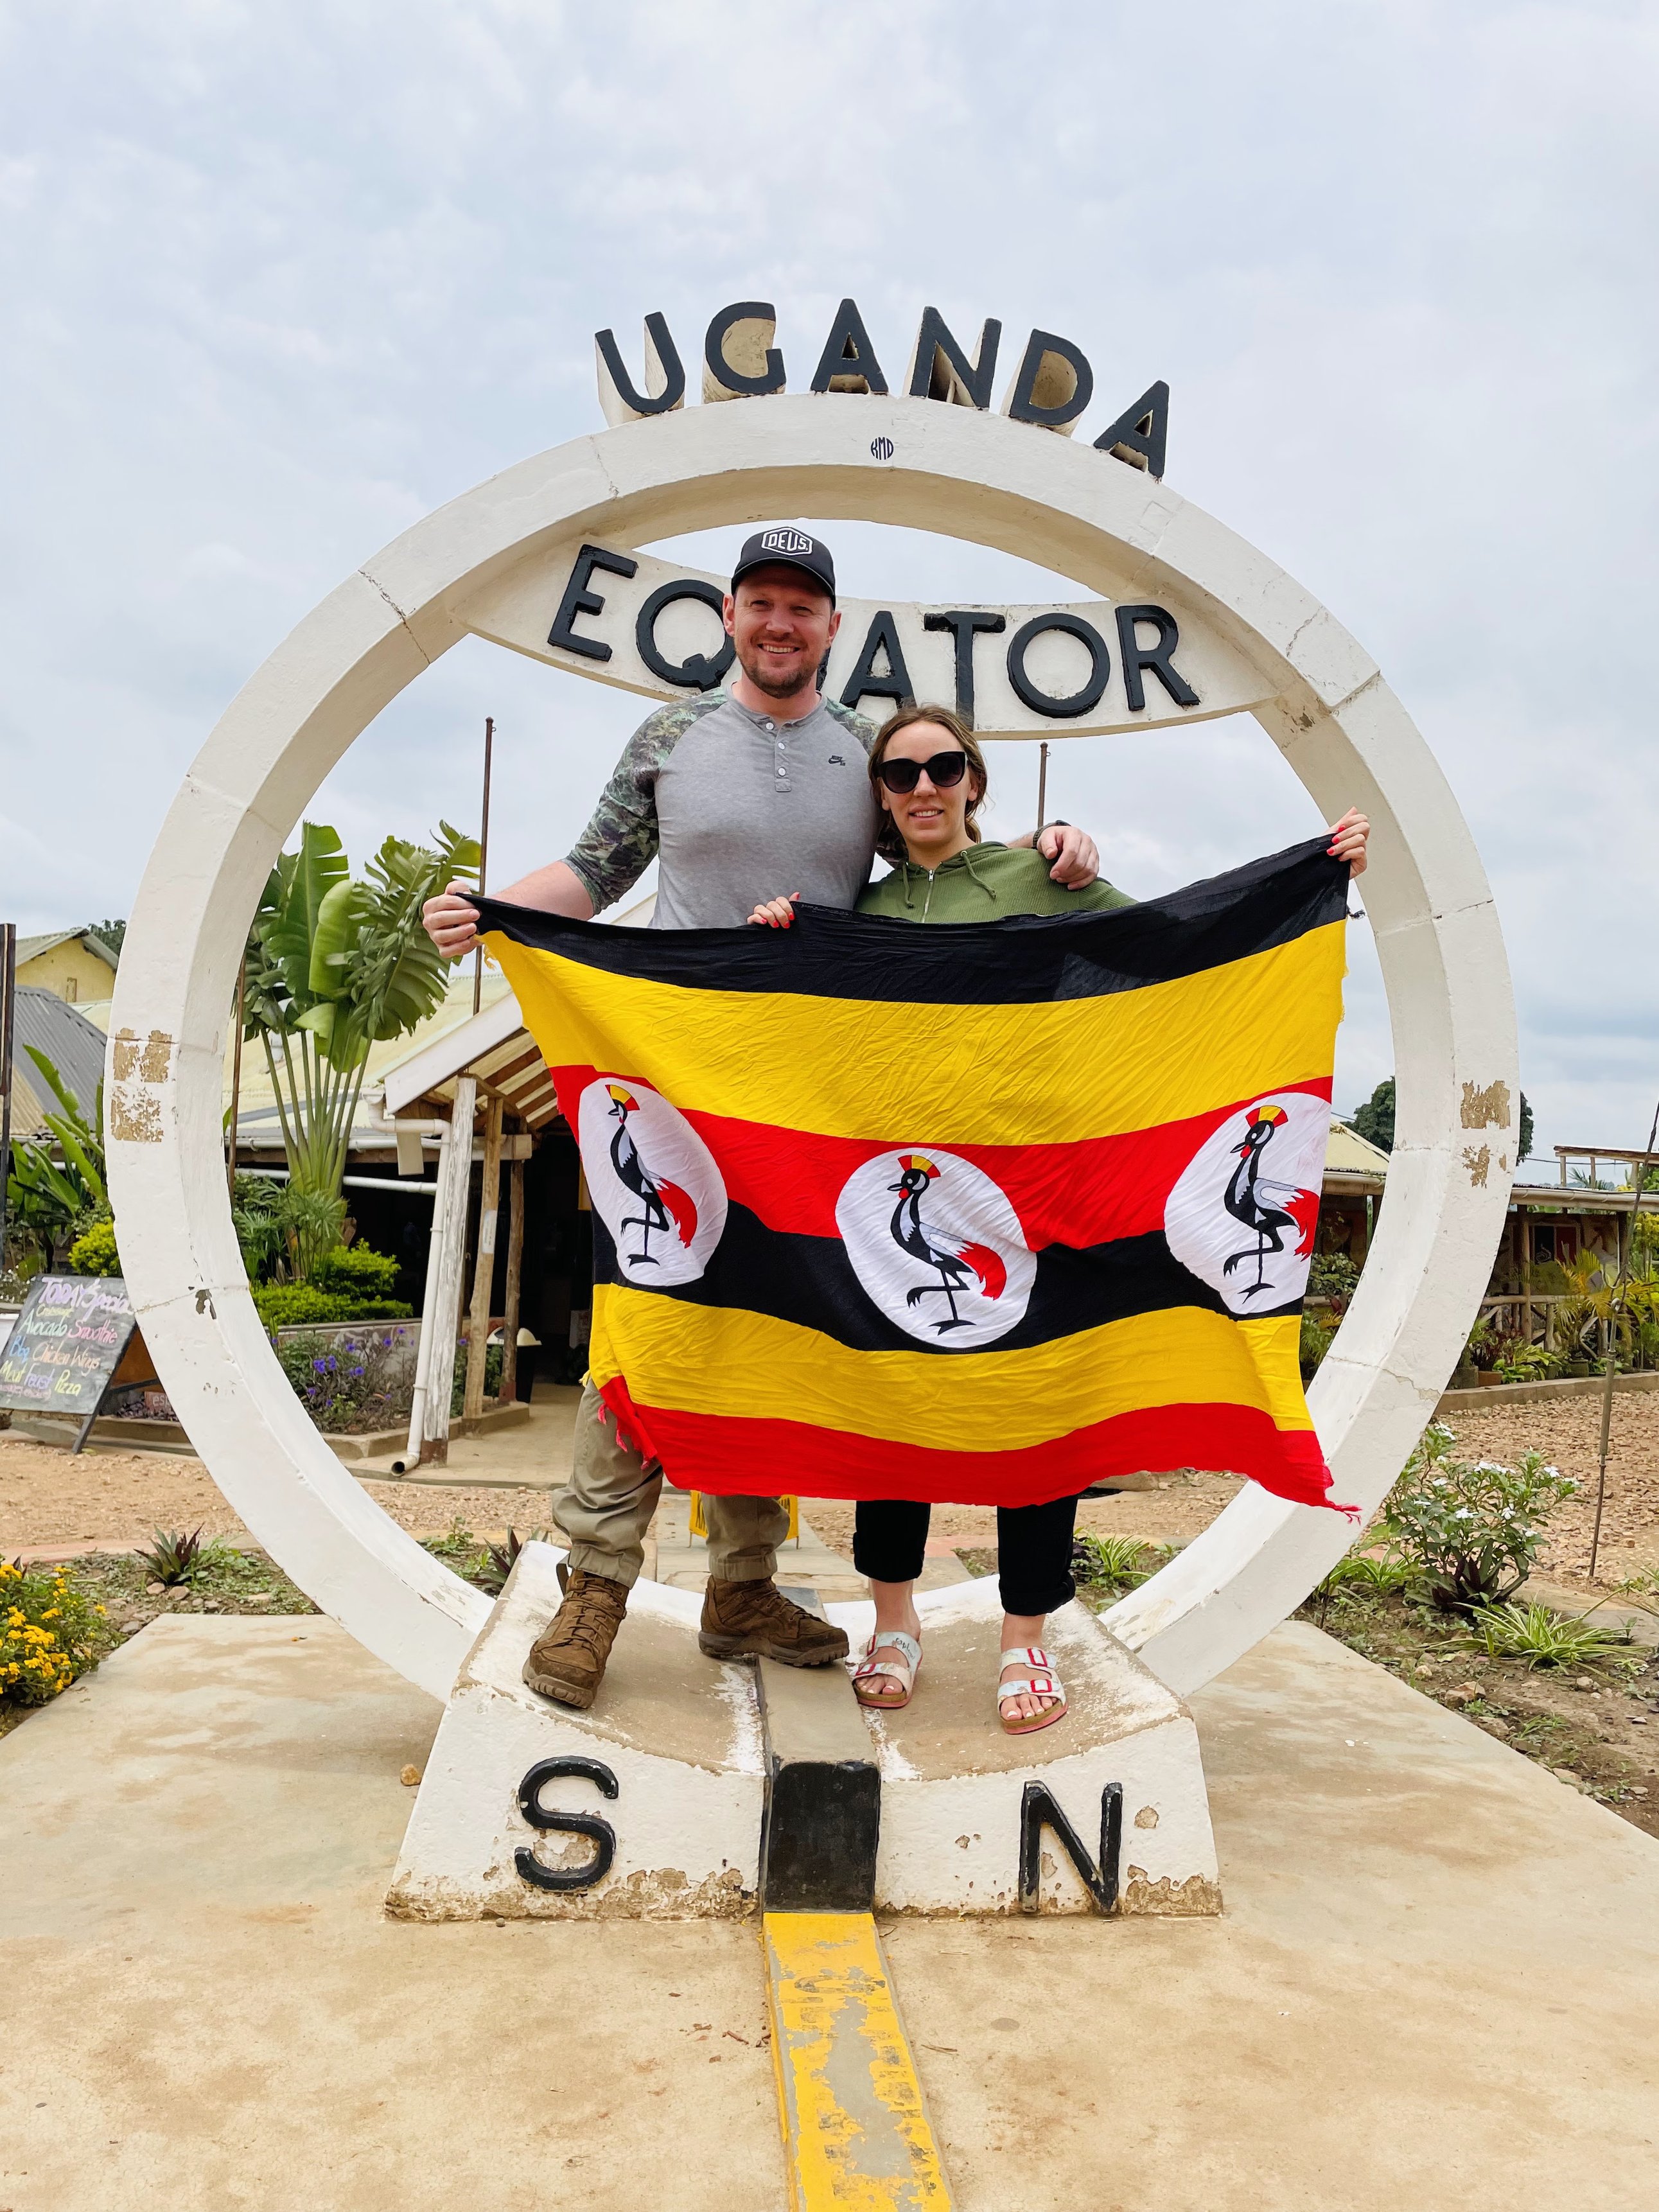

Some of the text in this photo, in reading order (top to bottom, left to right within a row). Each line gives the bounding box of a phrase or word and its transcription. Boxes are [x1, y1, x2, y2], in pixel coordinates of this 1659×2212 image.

[594, 298, 1170, 483] UGANDA
[870, 437, 894, 461] KMD
[768, 532, 808, 552] DEUS
[548, 544, 1202, 732] EQATOR
[17, 1308, 67, 1335] Avocado
[67, 1319, 118, 1344] Smoothie
[32, 1340, 71, 1365] Chicken
[71, 1345, 101, 1377] Wings
[55, 1369, 82, 1397] Pizza
[514, 1755, 1123, 1915] S N
